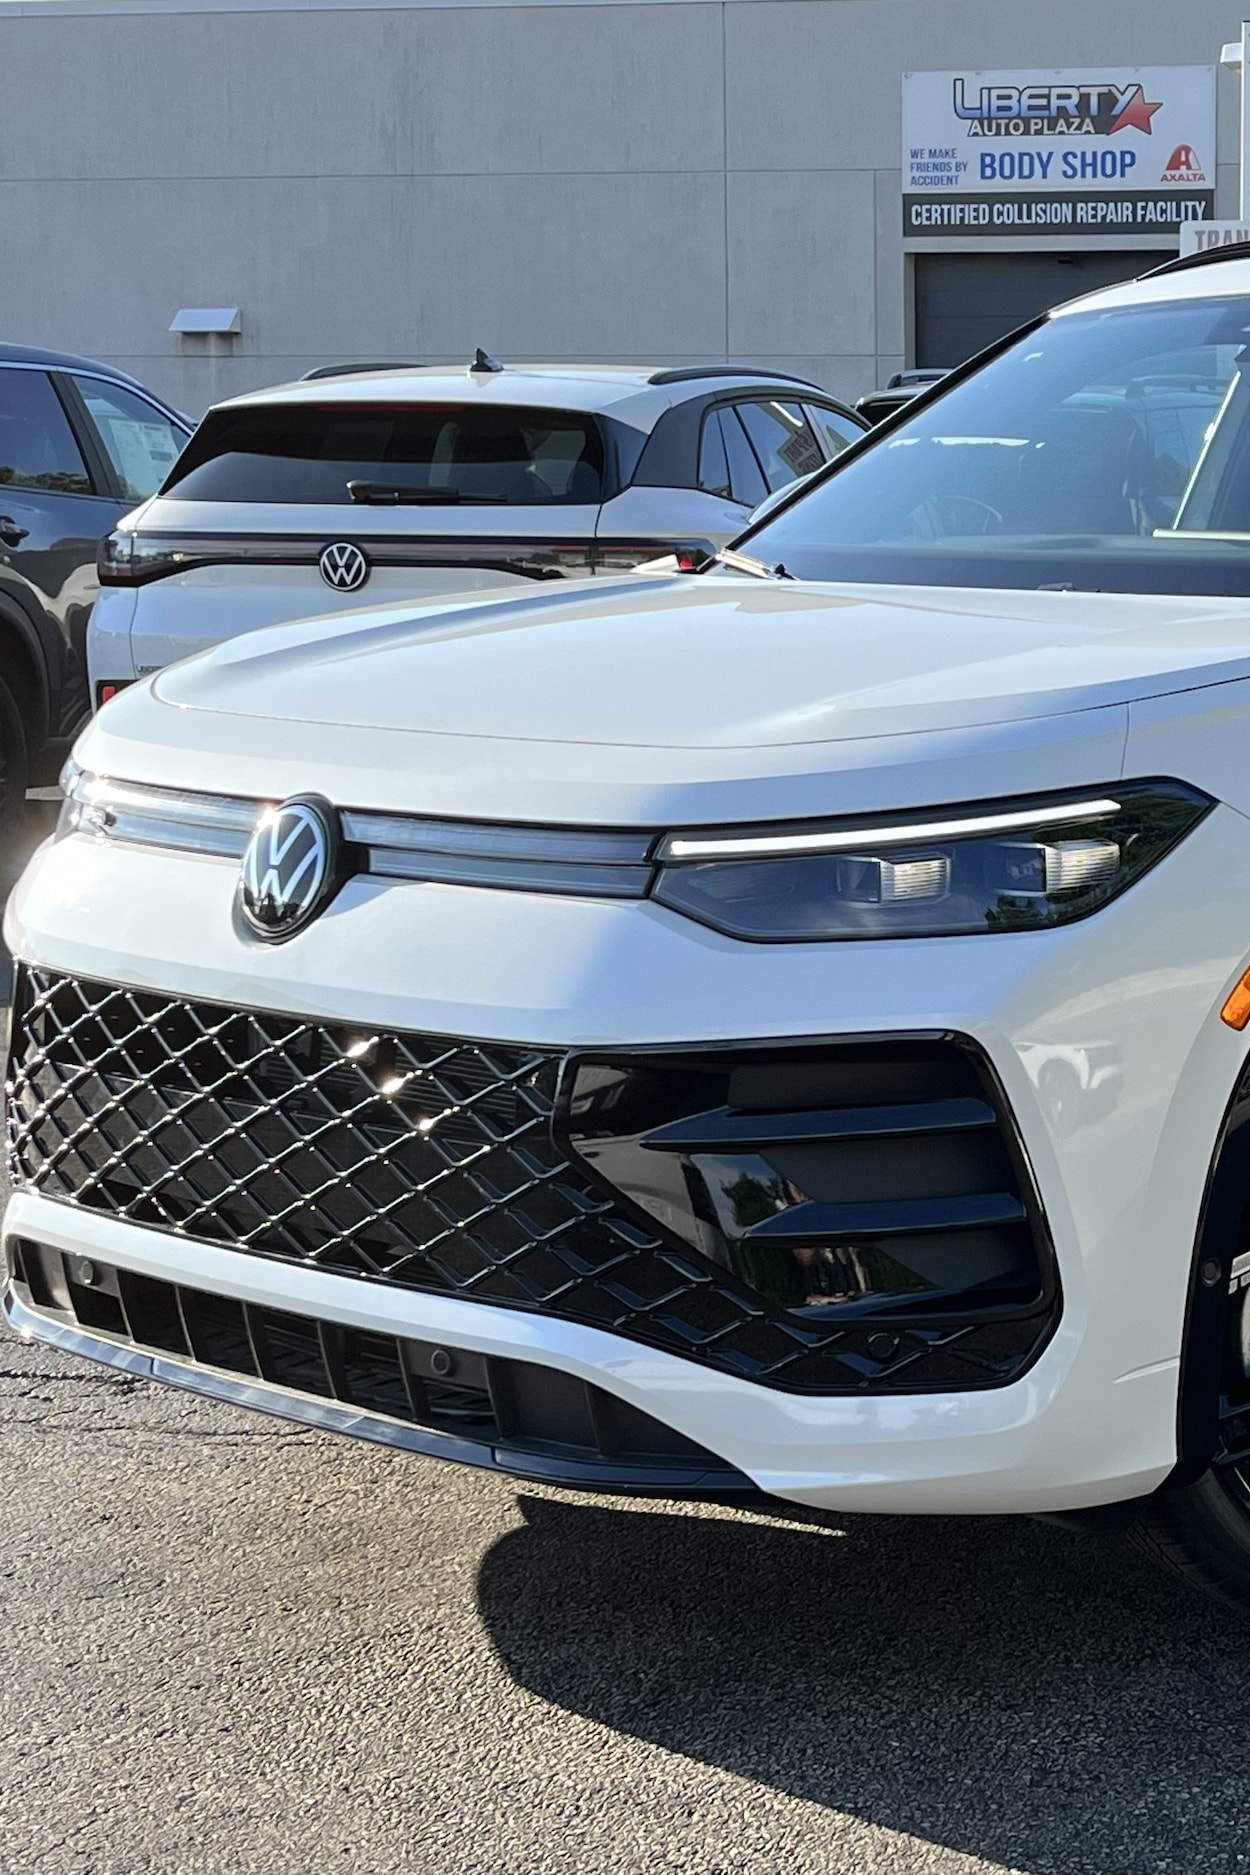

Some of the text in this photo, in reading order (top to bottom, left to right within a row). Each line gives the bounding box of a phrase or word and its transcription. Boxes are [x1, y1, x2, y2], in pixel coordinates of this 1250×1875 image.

[953, 78, 1142, 120] LIBERTY
[969, 117, 1096, 136] AUTO PLAZA
[910, 148, 958, 159] WE MAKE
[910, 162, 968, 173] FRIENDS BY
[980, 150, 1137, 180] BODY SHOP
[910, 175, 960, 186] ACCIDENT
[1160, 173, 1206, 183] AXALTA
[911, 200, 1206, 225] CERTIFIED COLLISION REPAIR FACILITY
[320, 542, 366, 592] VW
